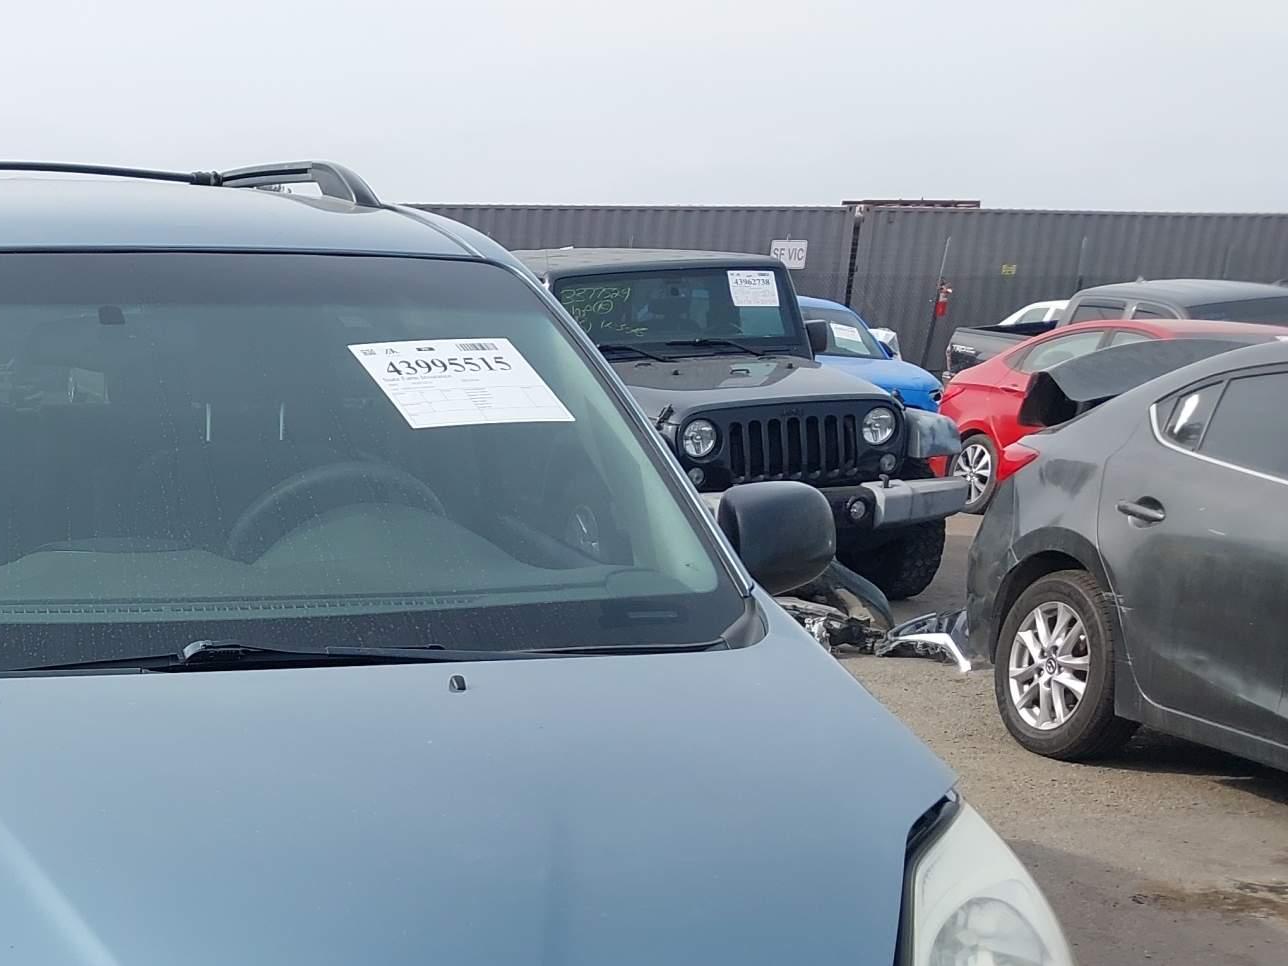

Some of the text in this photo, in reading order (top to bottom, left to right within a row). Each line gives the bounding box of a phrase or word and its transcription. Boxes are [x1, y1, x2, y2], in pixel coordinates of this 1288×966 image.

[787, 247, 804, 261] VIC
[734, 278, 770, 286] 43962738
[386, 356, 512, 376] 43995515
